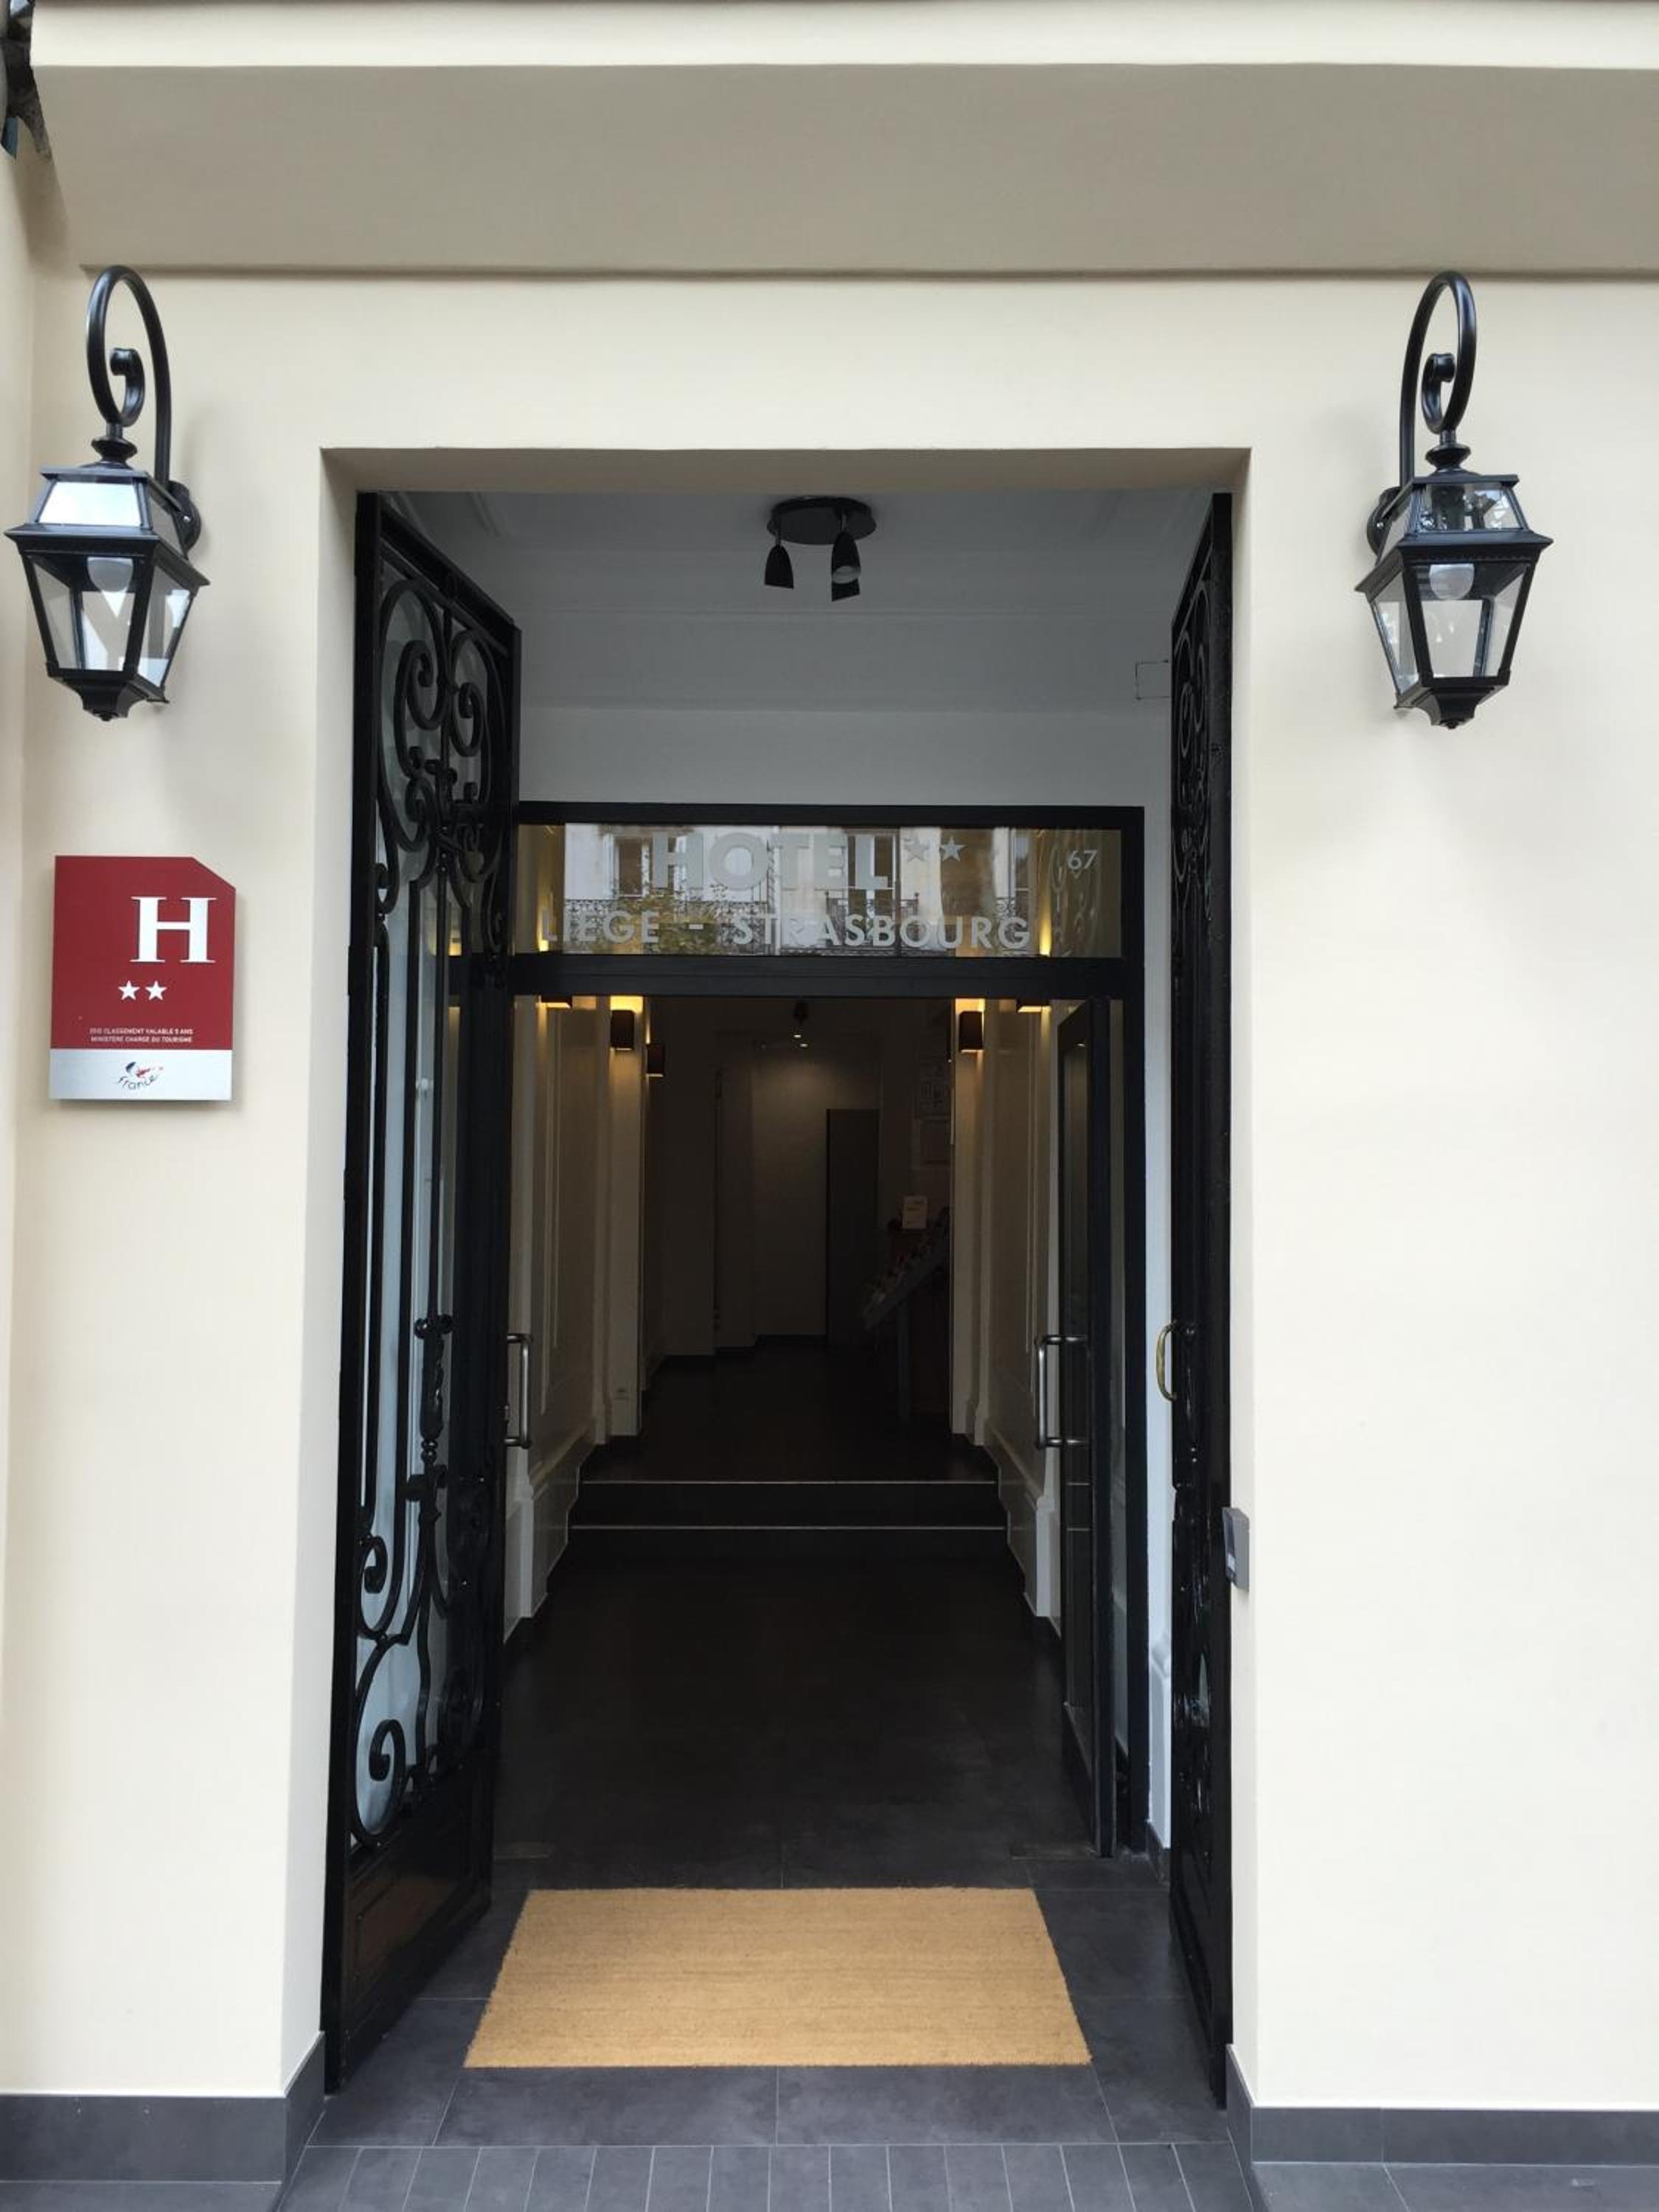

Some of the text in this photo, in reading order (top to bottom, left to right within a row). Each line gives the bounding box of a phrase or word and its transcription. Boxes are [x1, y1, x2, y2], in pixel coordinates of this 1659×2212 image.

[652, 832, 889, 891] HOTEL
[1067, 849, 1098, 870] 67
[129, 896, 217, 963] H
[732, 911, 1029, 950] STRASBOURG
